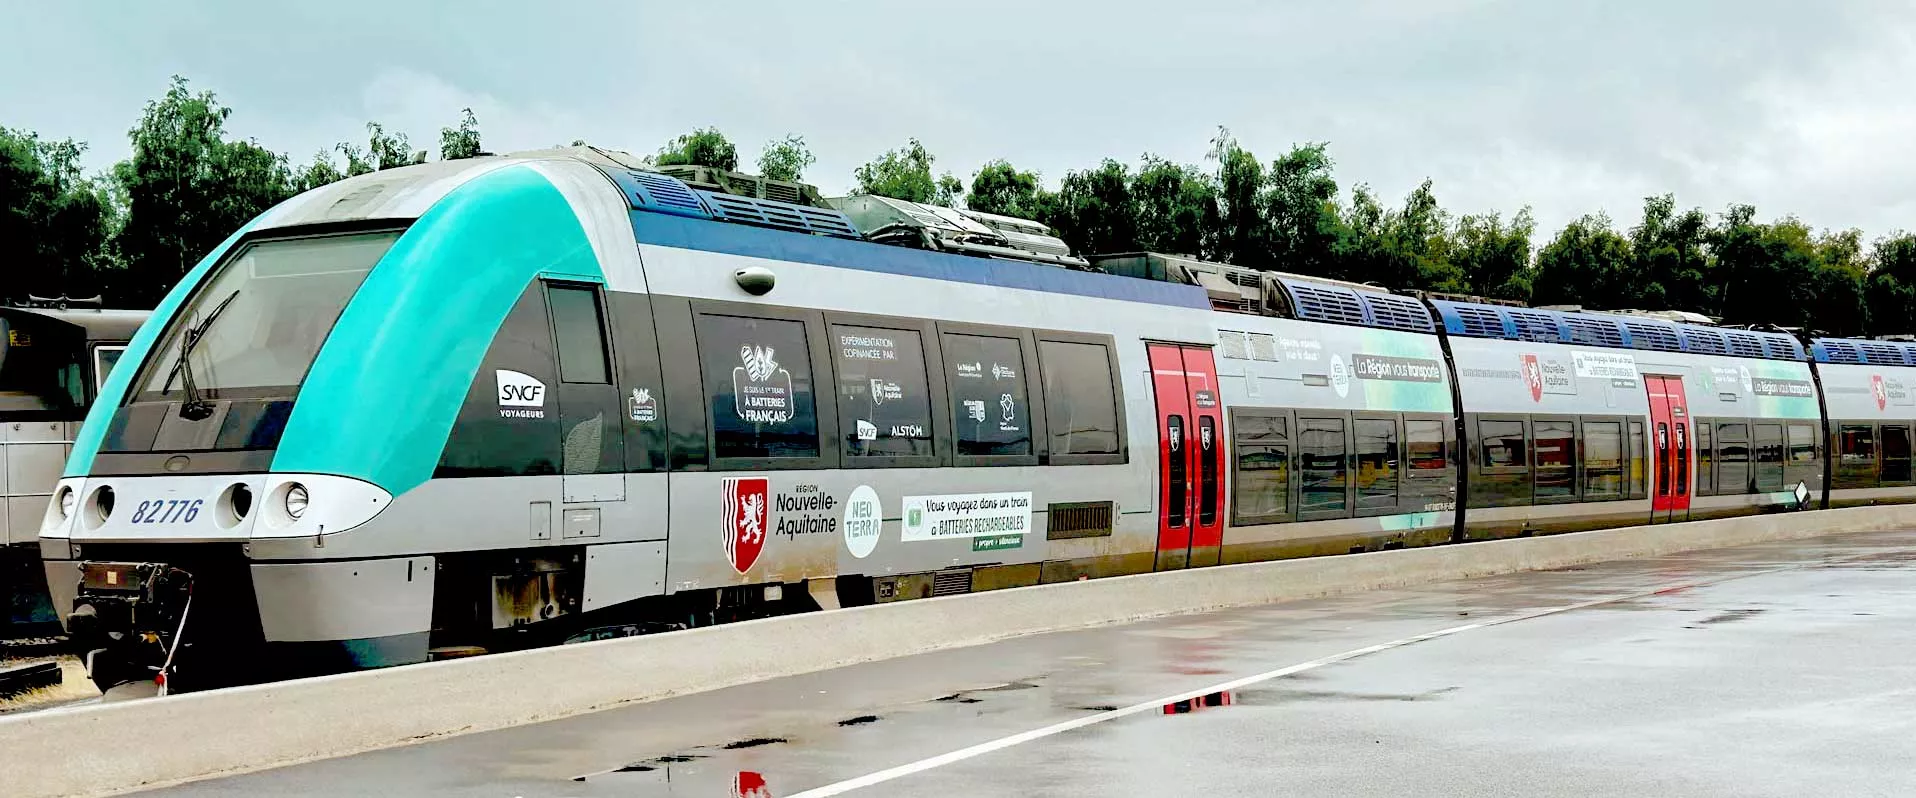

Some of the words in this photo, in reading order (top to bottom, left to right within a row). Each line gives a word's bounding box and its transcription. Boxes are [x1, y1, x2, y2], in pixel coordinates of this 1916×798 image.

[1356, 359, 1367, 374] La
[1367, 359, 1392, 378] Région
[1392, 363, 1408, 377] vous
[1407, 362, 1440, 380] transporte
[502, 384, 542, 400] SNCF
[751, 397, 785, 407] BATTERIES
[500, 410, 544, 418] VOYAGEURS
[746, 410, 787, 425] FRANÇAIS
[891, 425, 923, 437] ALSTOM
[131, 499, 204, 523] 82776
[776, 493, 838, 512] Nouvelle-
[852, 501, 872, 518] NEO
[926, 500, 945, 512] Vous
[947, 500, 977, 515] voyagez
[979, 498, 997, 510] dans
[999, 499, 1009, 508] un
[1010, 497, 1028, 508] train
[776, 514, 836, 540] Aquitaine
[846, 519, 879, 538] TERRA
[939, 518, 974, 535] BATTERIES
[974, 516, 1024, 533] RECHARGEABLES
